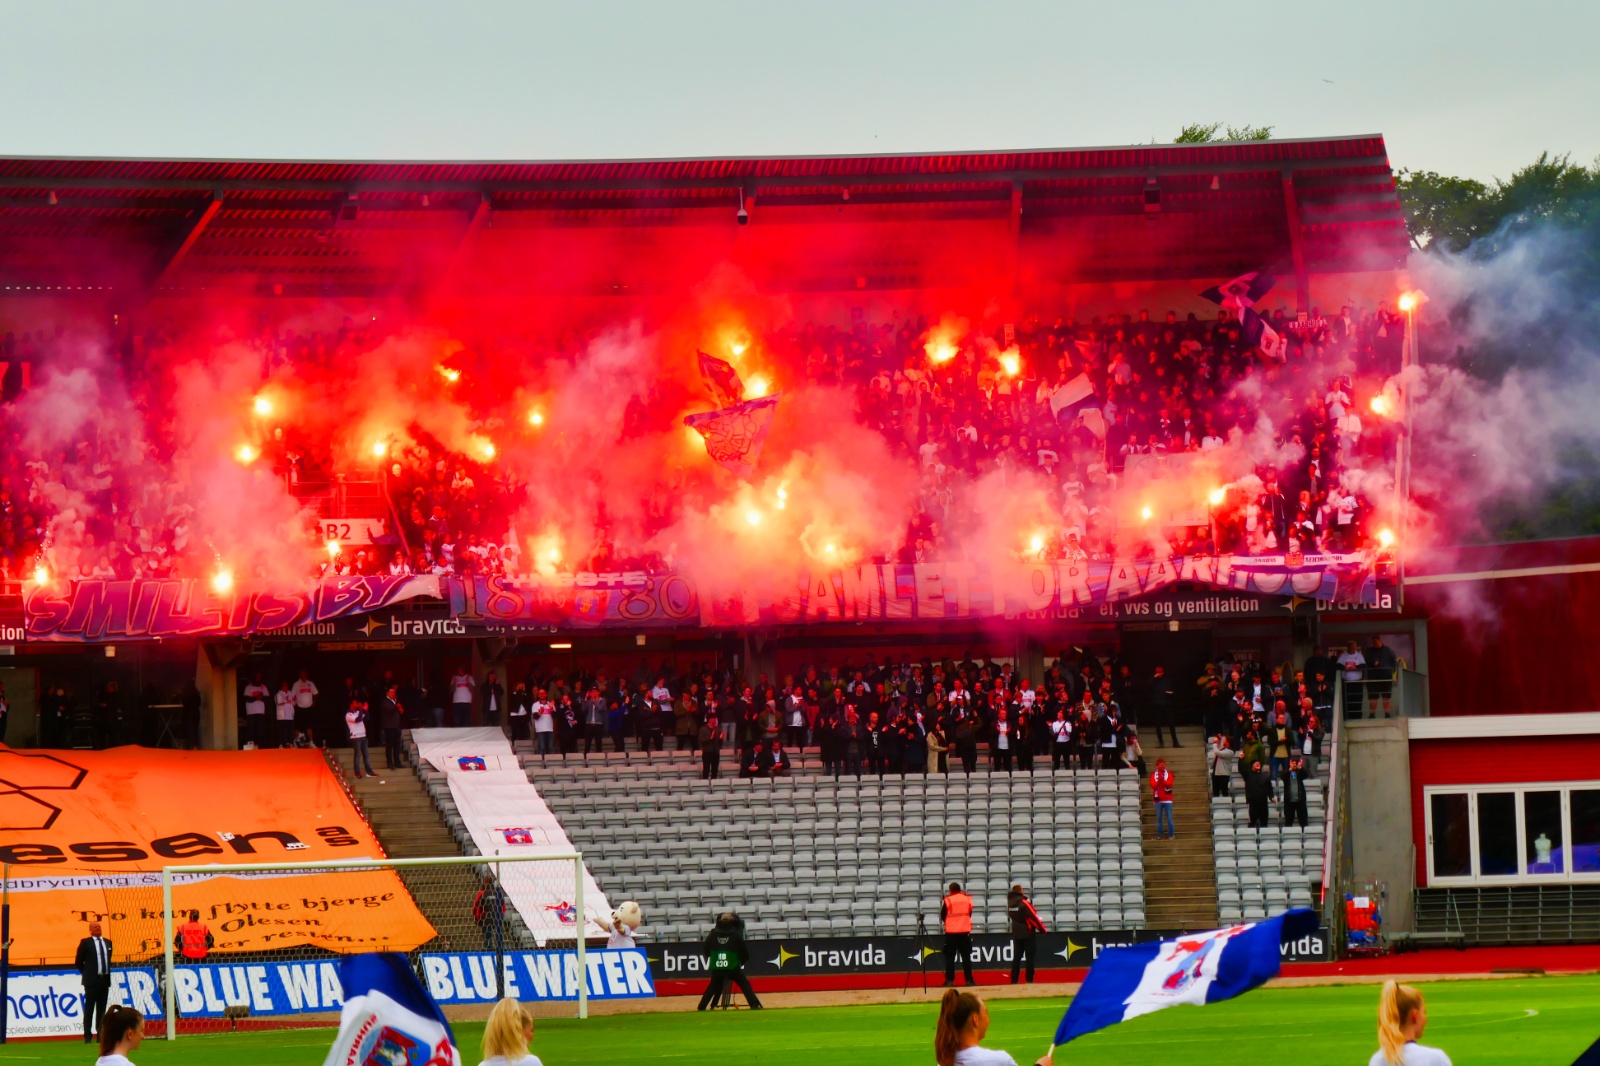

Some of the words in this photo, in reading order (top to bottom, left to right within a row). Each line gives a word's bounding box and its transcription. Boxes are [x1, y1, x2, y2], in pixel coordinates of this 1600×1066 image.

[326, 523, 352, 541] B2
[316, 576, 404, 620] BY
[1100, 602, 1119, 618] el,
[1124, 602, 1150, 615] vvs
[1154, 600, 1173, 617] og
[1177, 596, 1259, 615] ventilation
[0, 624, 25, 641] ion
[0, 831, 303, 865] esen
[71, 909, 127, 923] Tro
[207, 902, 291, 921] flytte
[301, 892, 395, 912] bjerge
[220, 914, 324, 933] Olesen
[804, 942, 886, 967] bravida
[174, 963, 273, 1013] BLUE
[423, 954, 521, 1001] BLUE
[523, 951, 654, 999] WATER
[48, 1023, 71, 1033] siden
